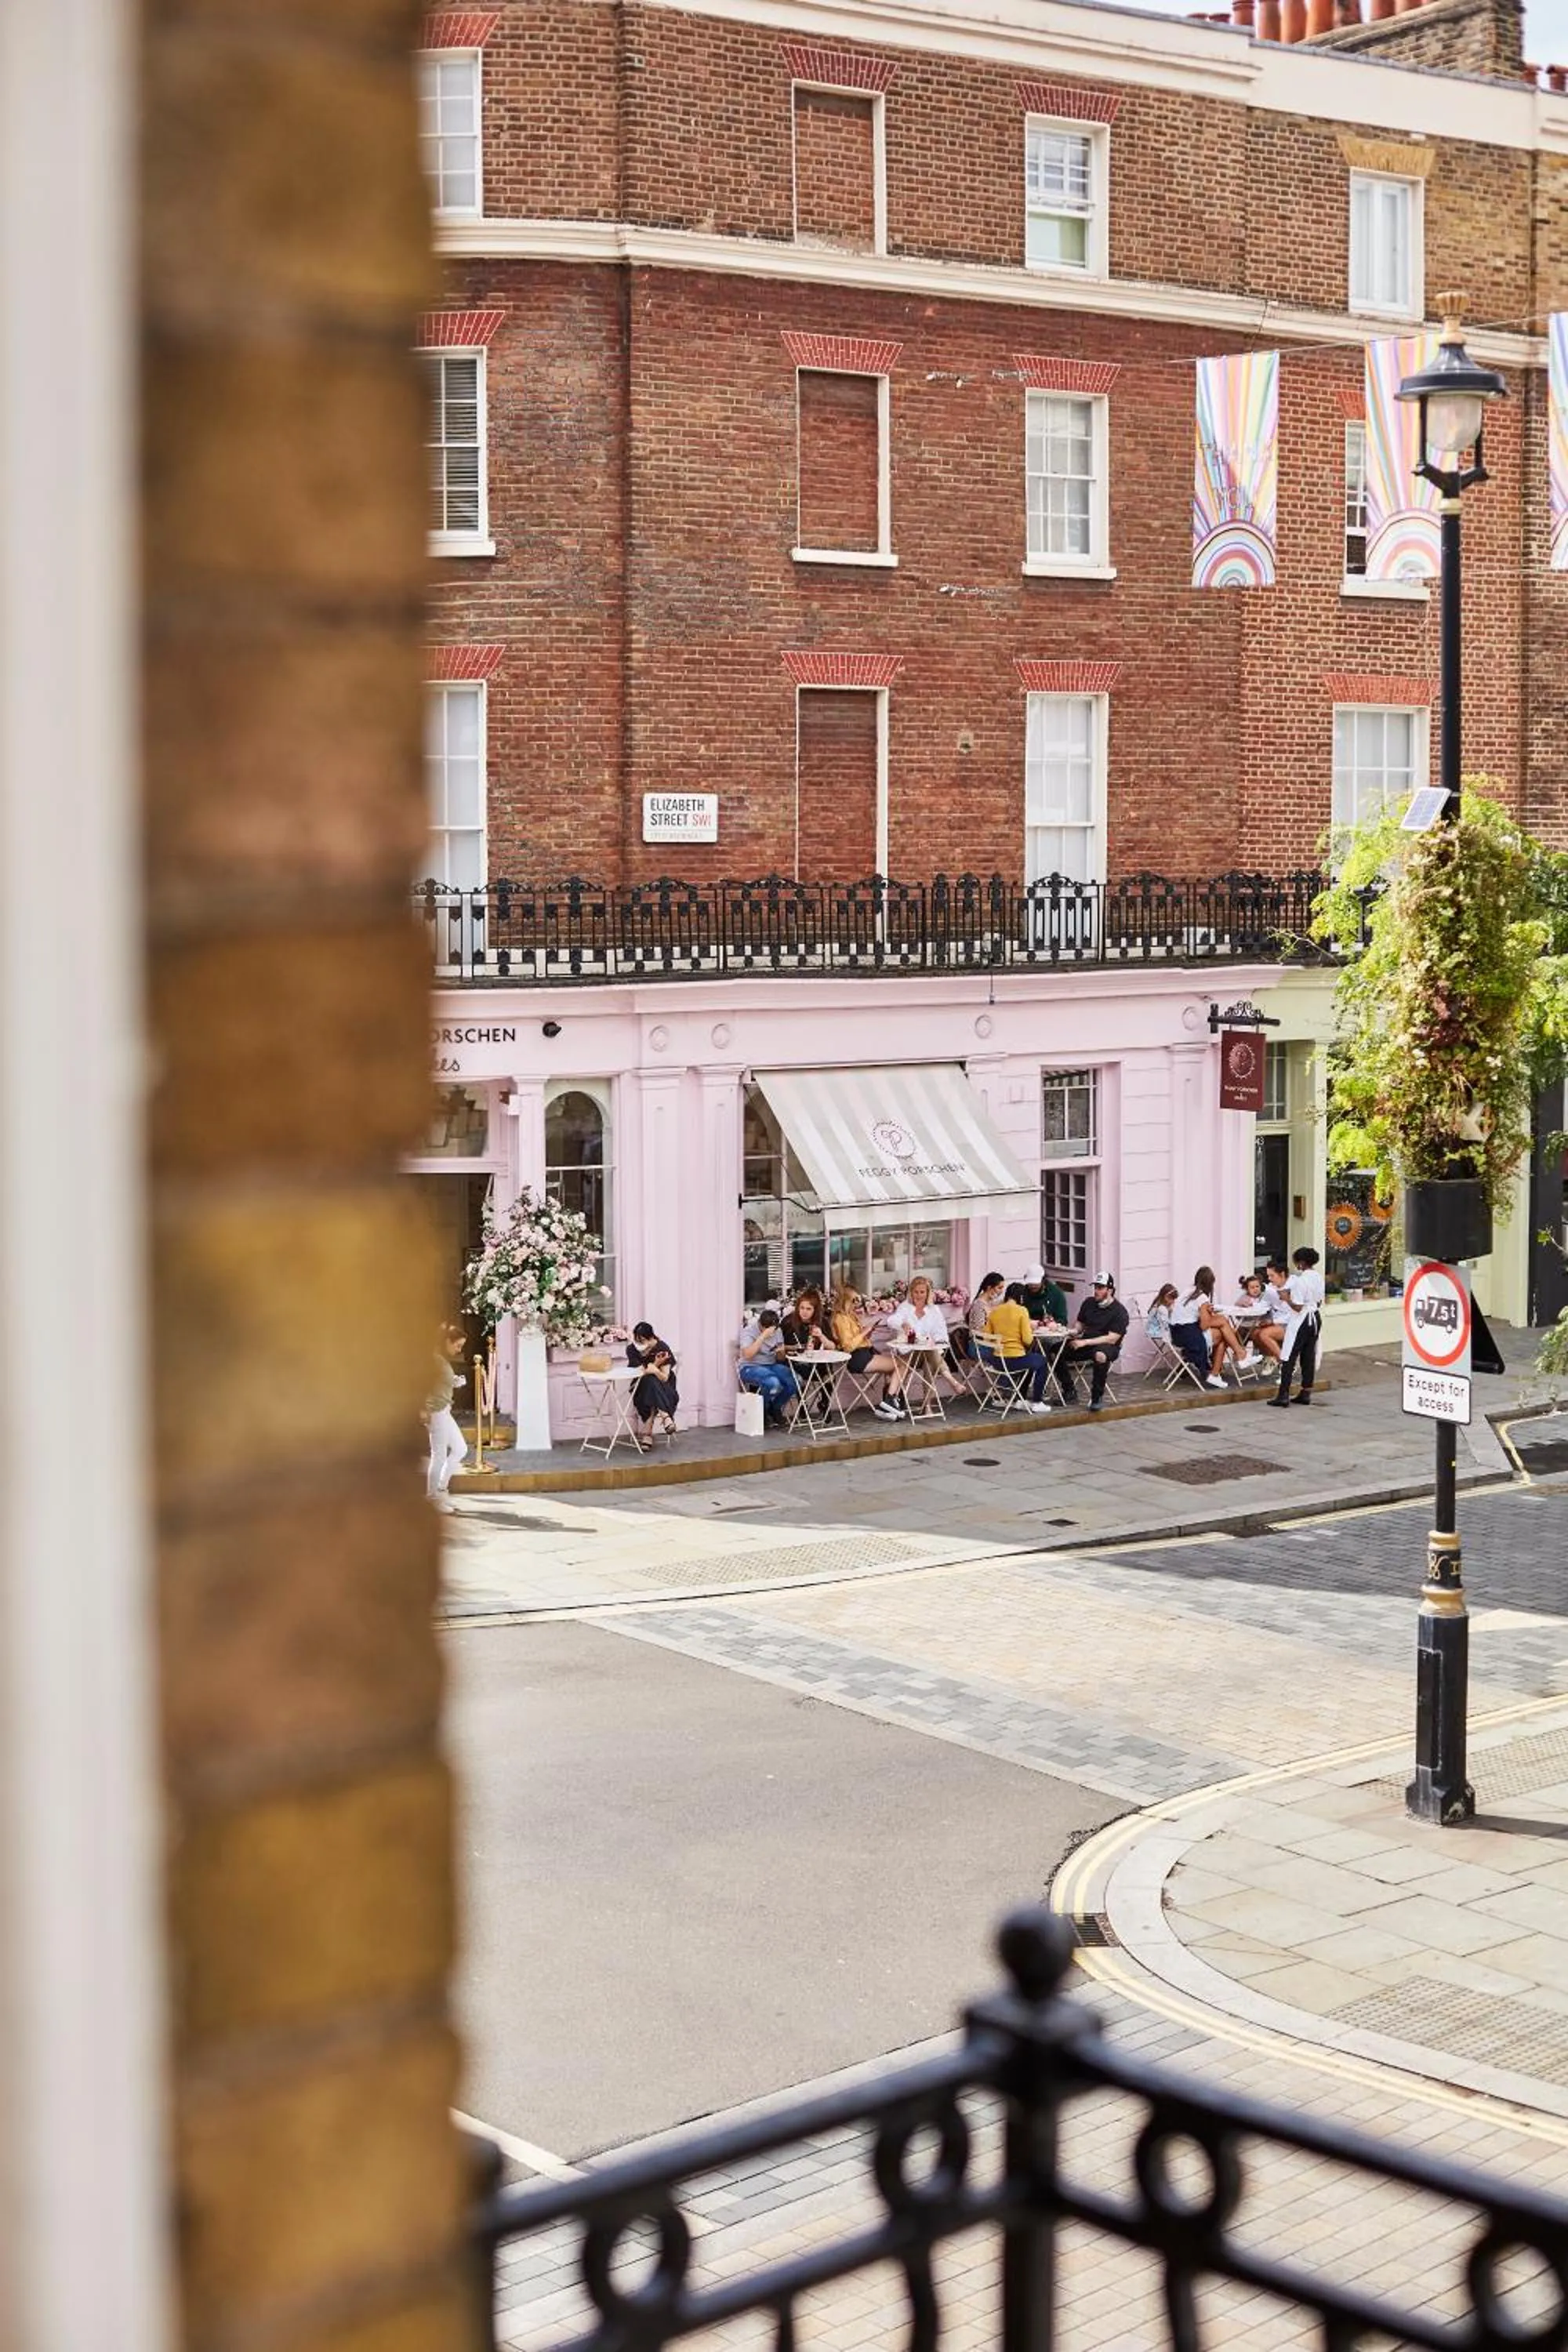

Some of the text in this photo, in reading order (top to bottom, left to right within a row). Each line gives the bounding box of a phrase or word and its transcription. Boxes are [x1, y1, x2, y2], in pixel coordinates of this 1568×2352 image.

[650, 798, 705, 811] ELIZABETH
[650, 813, 688, 826] STREET
[1408, 1374, 1465, 1397] Except for
[1417, 1396, 1454, 1413] access
